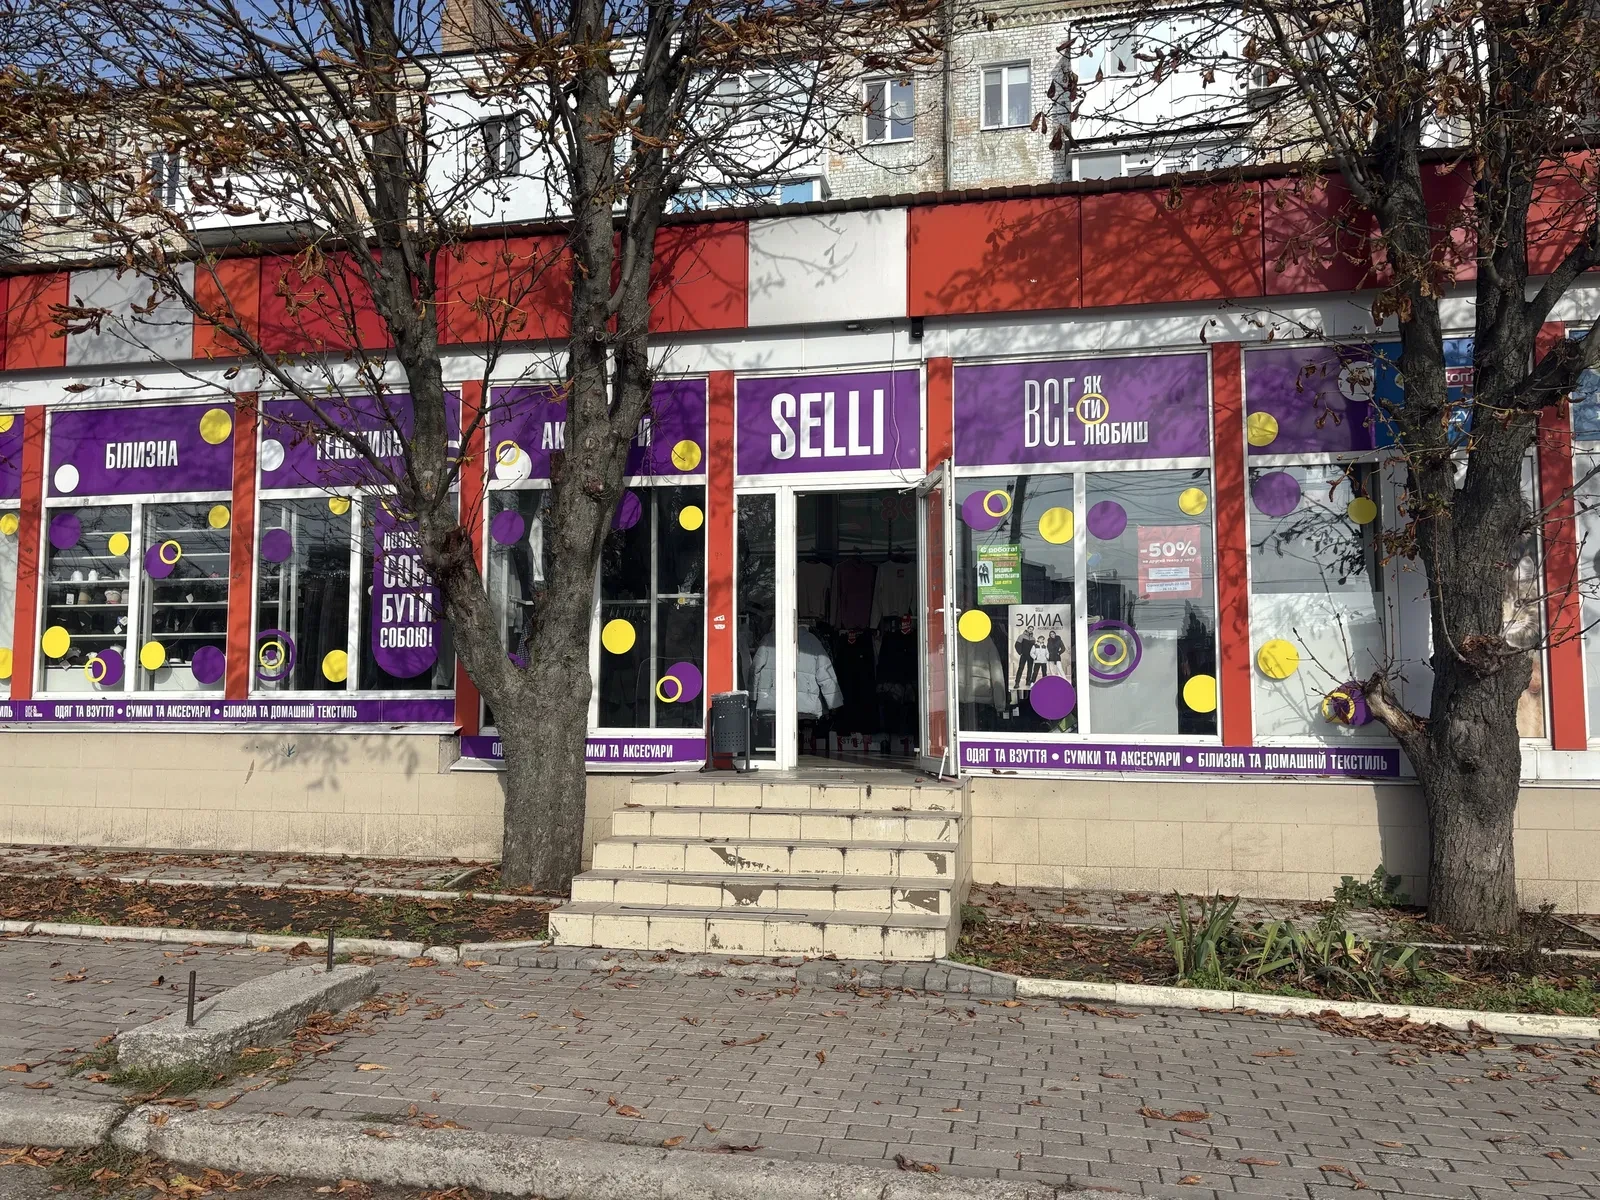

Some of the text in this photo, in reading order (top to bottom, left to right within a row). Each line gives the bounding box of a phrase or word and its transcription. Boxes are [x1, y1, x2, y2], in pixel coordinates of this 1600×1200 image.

[1083, 375, 1102, 394] ЯК
[1024, 378, 1076, 448] ВСЕ
[1083, 399, 1101, 419] ТИ
[770, 389, 884, 460] SELLI
[1083, 421, 1149, 446] ЛЮБИШ
[105, 440, 178, 470] БІЛИЗНА
[988, 546, 1018, 554] робота!
[1140, 540, 1197, 558] -50%
[381, 593, 433, 623] БУТИ
[1016, 613, 1064, 627] ЗИМА
[380, 626, 433, 649] СОБОЮ!
[54, 705, 74, 719] ОДЯГ
[75, 705, 85, 718] ТА
[86, 705, 114, 718] ВЗУТТЯ
[126, 705, 153, 718] СУМКИ
[155, 705, 165, 718] ТА
[166, 705, 211, 718] АКСЕСУАРИ
[222, 705, 257, 718] БІЛИЗНА
[260, 705, 269, 718] ТА
[270, 703, 315, 719] ДОМАШНІЙ
[317, 705, 358, 718] ТЕКСТИЛЬ
[492, 742, 673, 758] ОД МКИ ТА АКСЕСУАРИ
[966, 747, 1388, 771] ОДЯГ ТА ВЗУТТЯ СУМКИ ТА АКСЕСУАРИ БІЛИЗНА ТА ДОМАШНІЙ ТЕКСТИЛЬ
